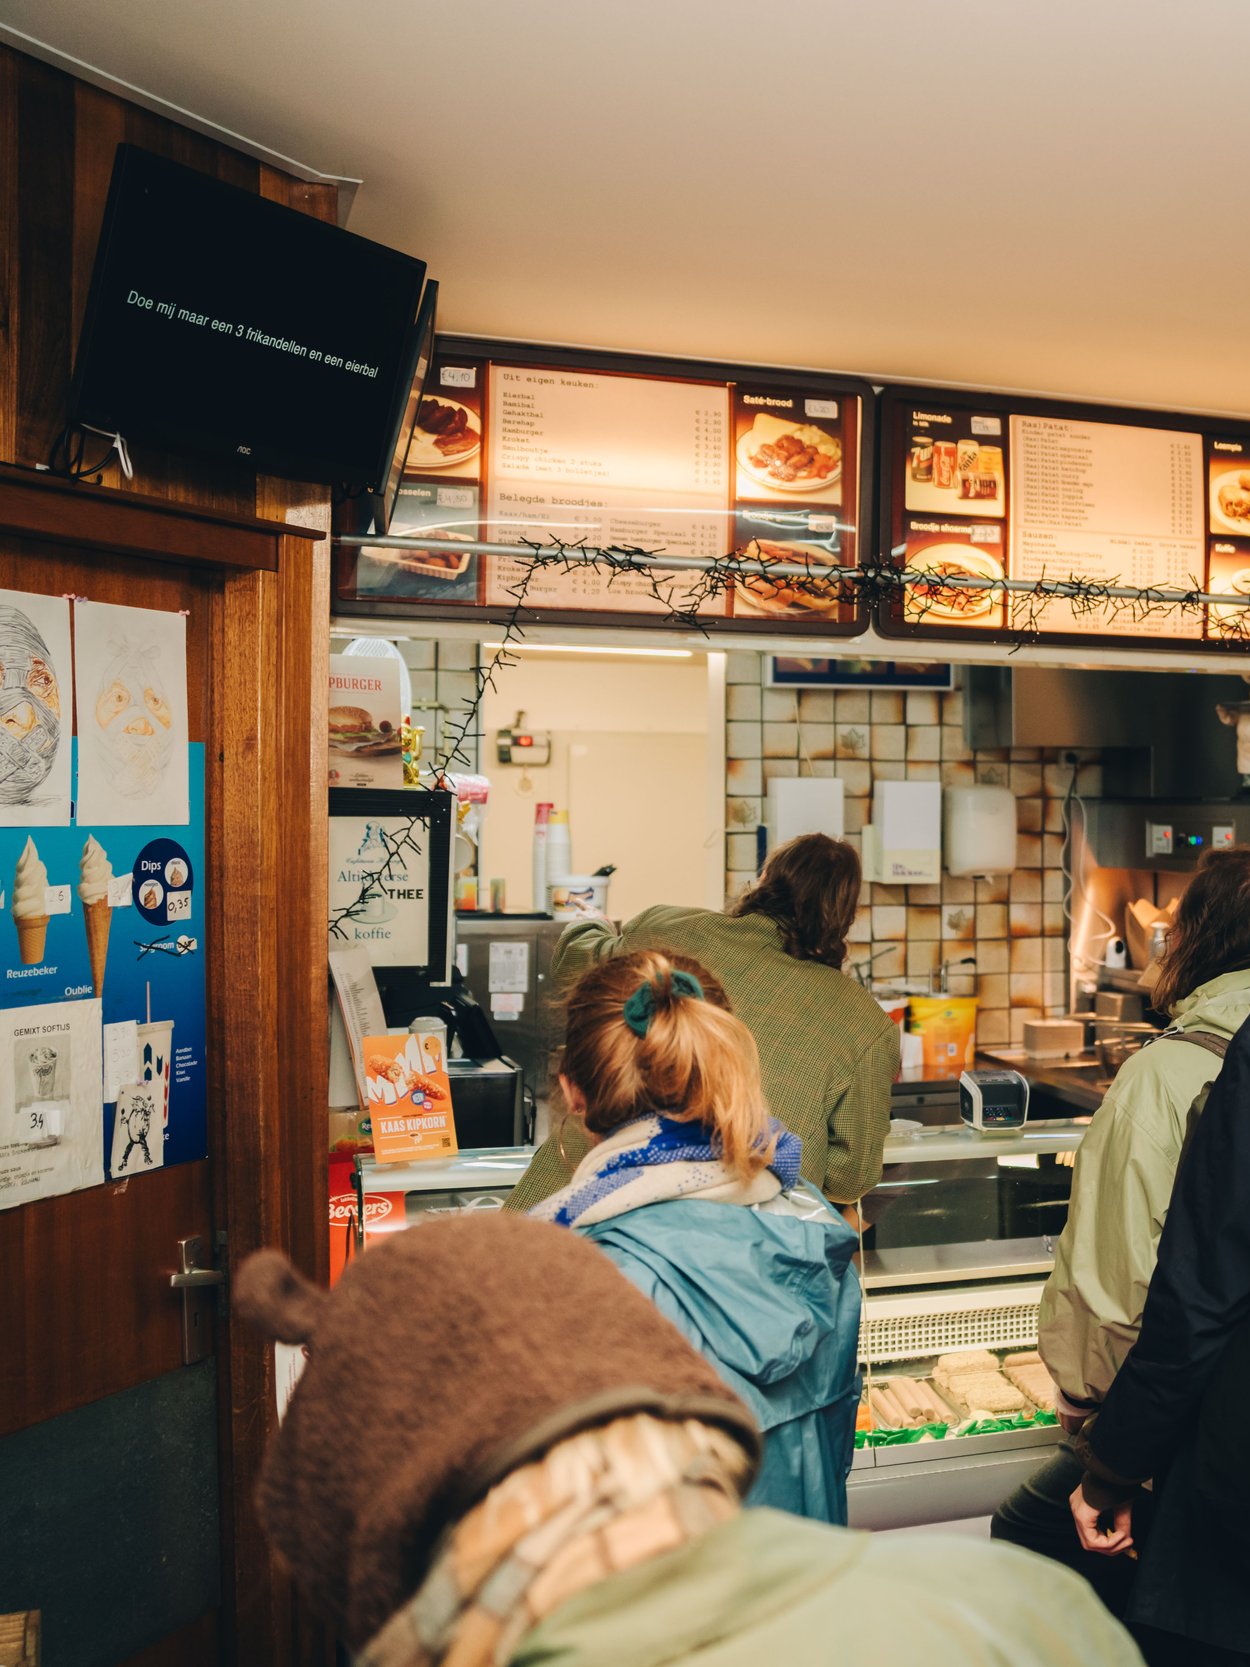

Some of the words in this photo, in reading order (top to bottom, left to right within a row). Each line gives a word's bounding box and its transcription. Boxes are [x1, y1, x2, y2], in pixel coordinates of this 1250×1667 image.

[127, 290, 153, 310] Doe
[156, 300, 177, 320] mij
[178, 307, 209, 327] maar
[211, 317, 233, 334] een
[235, 324, 245, 337] 3
[246, 326, 307, 358] frikandellen
[309, 347, 323, 362] en
[325, 352, 343, 368] een
[345, 357, 379, 379] eierbal
[503, 373, 521, 382] Uit
[526, 376, 555, 386] eigen
[560, 378, 599, 389] keuken:
[503, 391, 535, 400] Eierbal
[744, 395, 793, 408] Saté-brood
[502, 400, 535, 409] Bamibal
[912, 410, 953, 424] Limonade
[502, 427, 544, 437] Hamburger
[502, 436, 530, 444] Kroket
[500, 493, 545, 505] Belegde
[552, 496, 608, 508] broodjes:
[911, 522, 940, 534] Broodje
[498, 575, 540, 583] Kipburer
[328, 676, 383, 692] PBURGER
[141, 860, 162, 875] Dips
[337, 869, 375, 883] Altid
[387, 888, 424, 900] THEE
[354, 927, 392, 940] koffie
[6, 965, 58, 980] Reuzebeker
[64, 984, 93, 997] Oublie
[14, 1026, 40, 1038] GEMIXT
[42, 1022, 71, 1034] SOFTIJS
[380, 1119, 406, 1134] KAAS
[407, 1116, 447, 1131] KIPKORN
[329, 1201, 388, 1219] Becers
